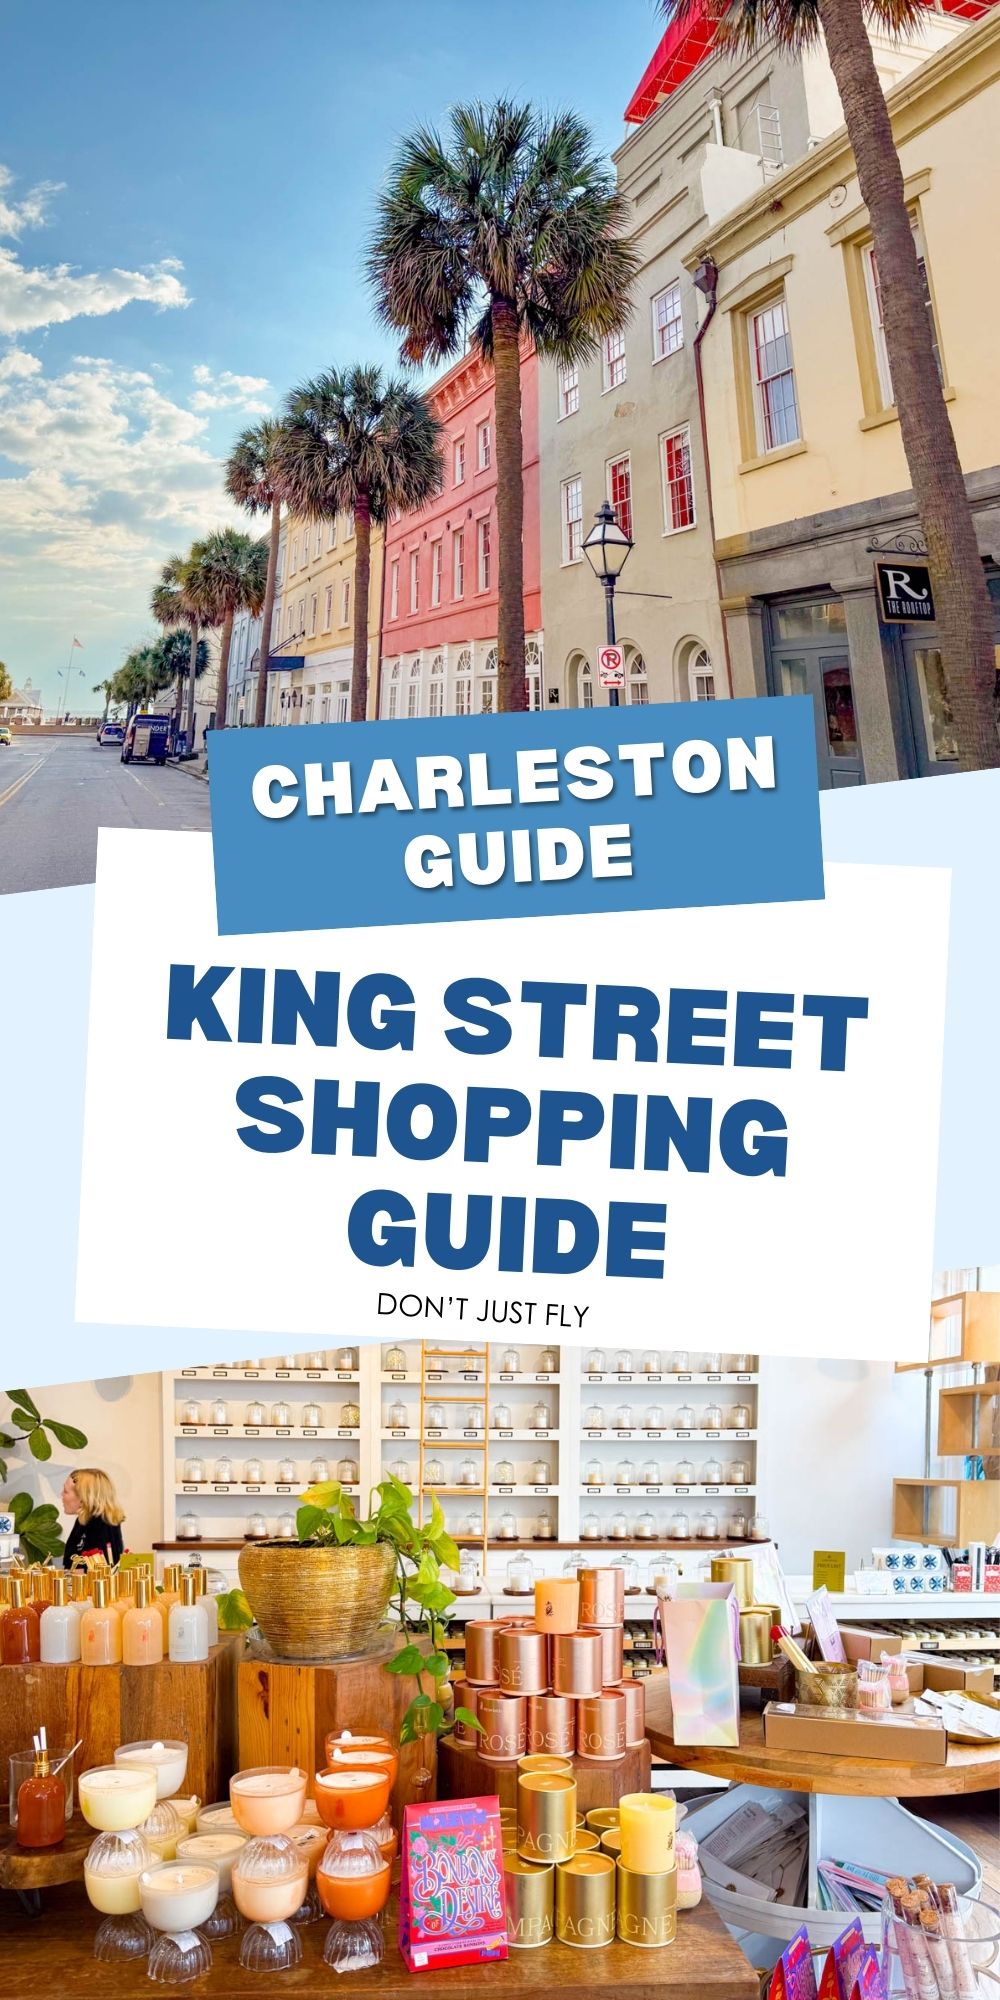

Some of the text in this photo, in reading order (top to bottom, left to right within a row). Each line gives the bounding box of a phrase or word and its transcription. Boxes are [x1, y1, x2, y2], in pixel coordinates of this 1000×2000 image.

[882, 569, 928, 600] R
[887, 600, 931, 615] THE ROOFTOP
[411, 1846, 502, 1898] BONBONS
[426, 1882, 504, 1932] DESIRE
